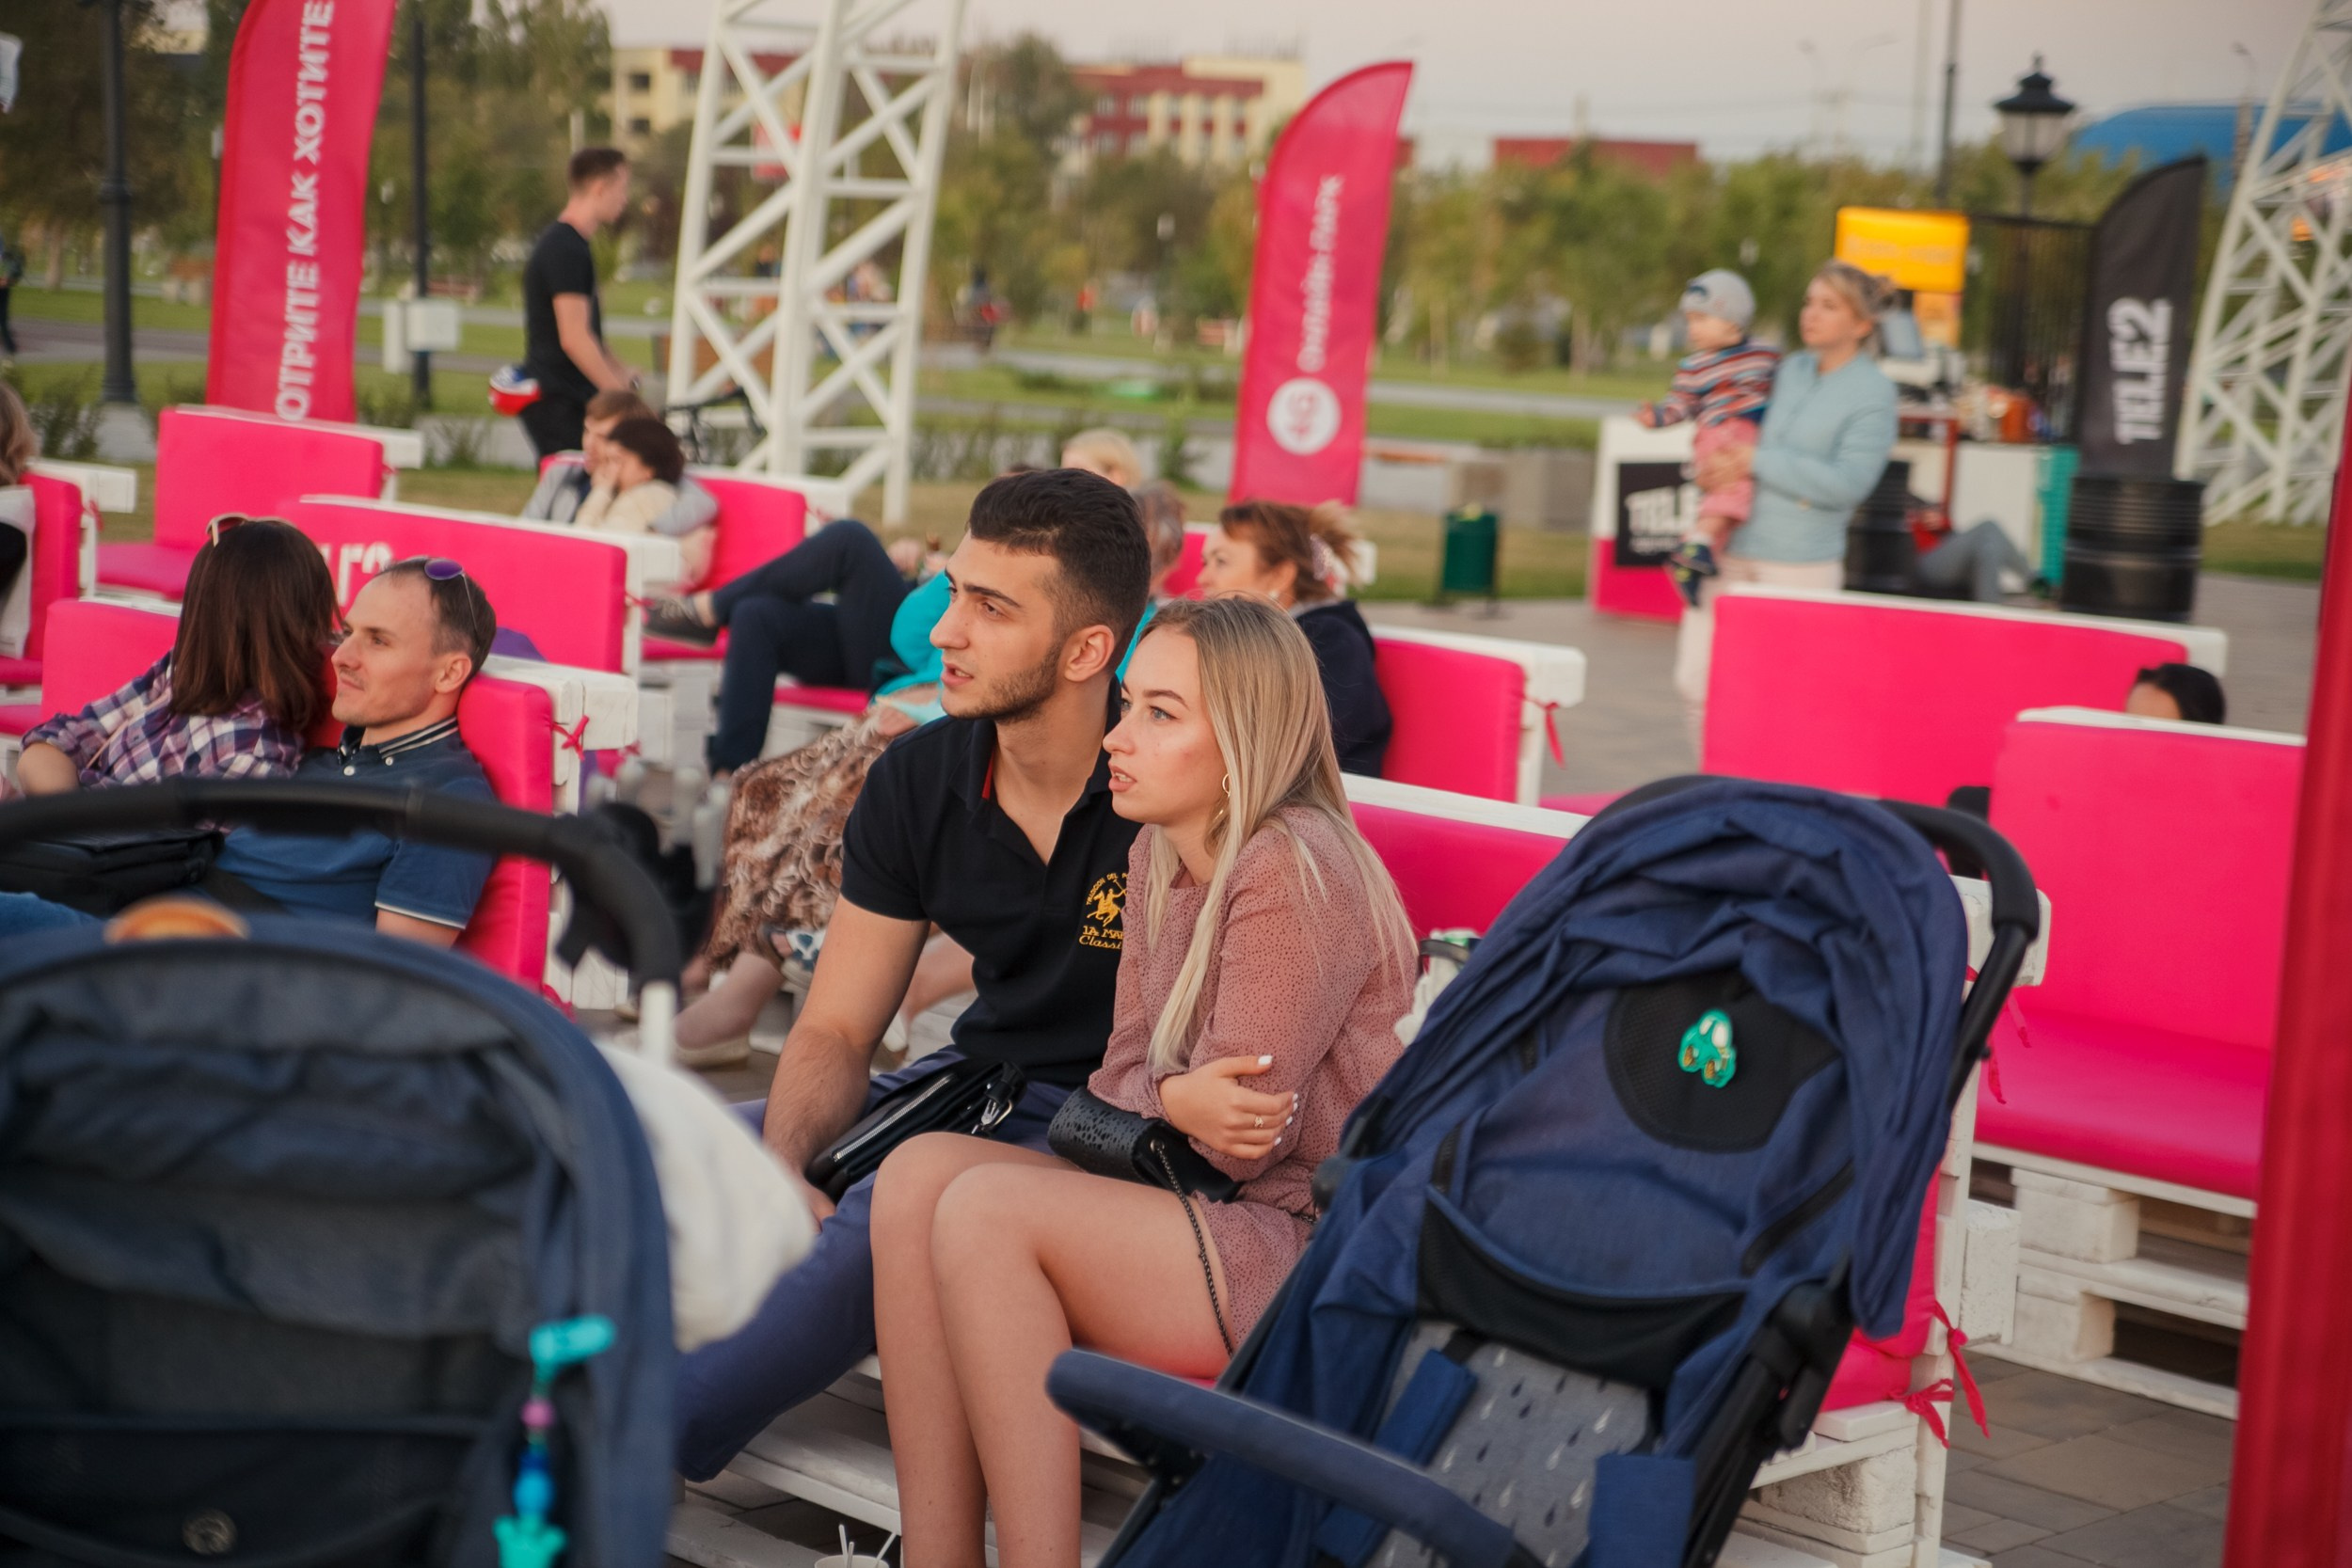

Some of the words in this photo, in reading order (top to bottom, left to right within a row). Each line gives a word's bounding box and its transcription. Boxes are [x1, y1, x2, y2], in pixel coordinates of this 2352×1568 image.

[293, 0, 334, 166] ХОТИТЕ
[286, 170, 320, 257] КАК
[2106, 296, 2172, 445] TELE2
